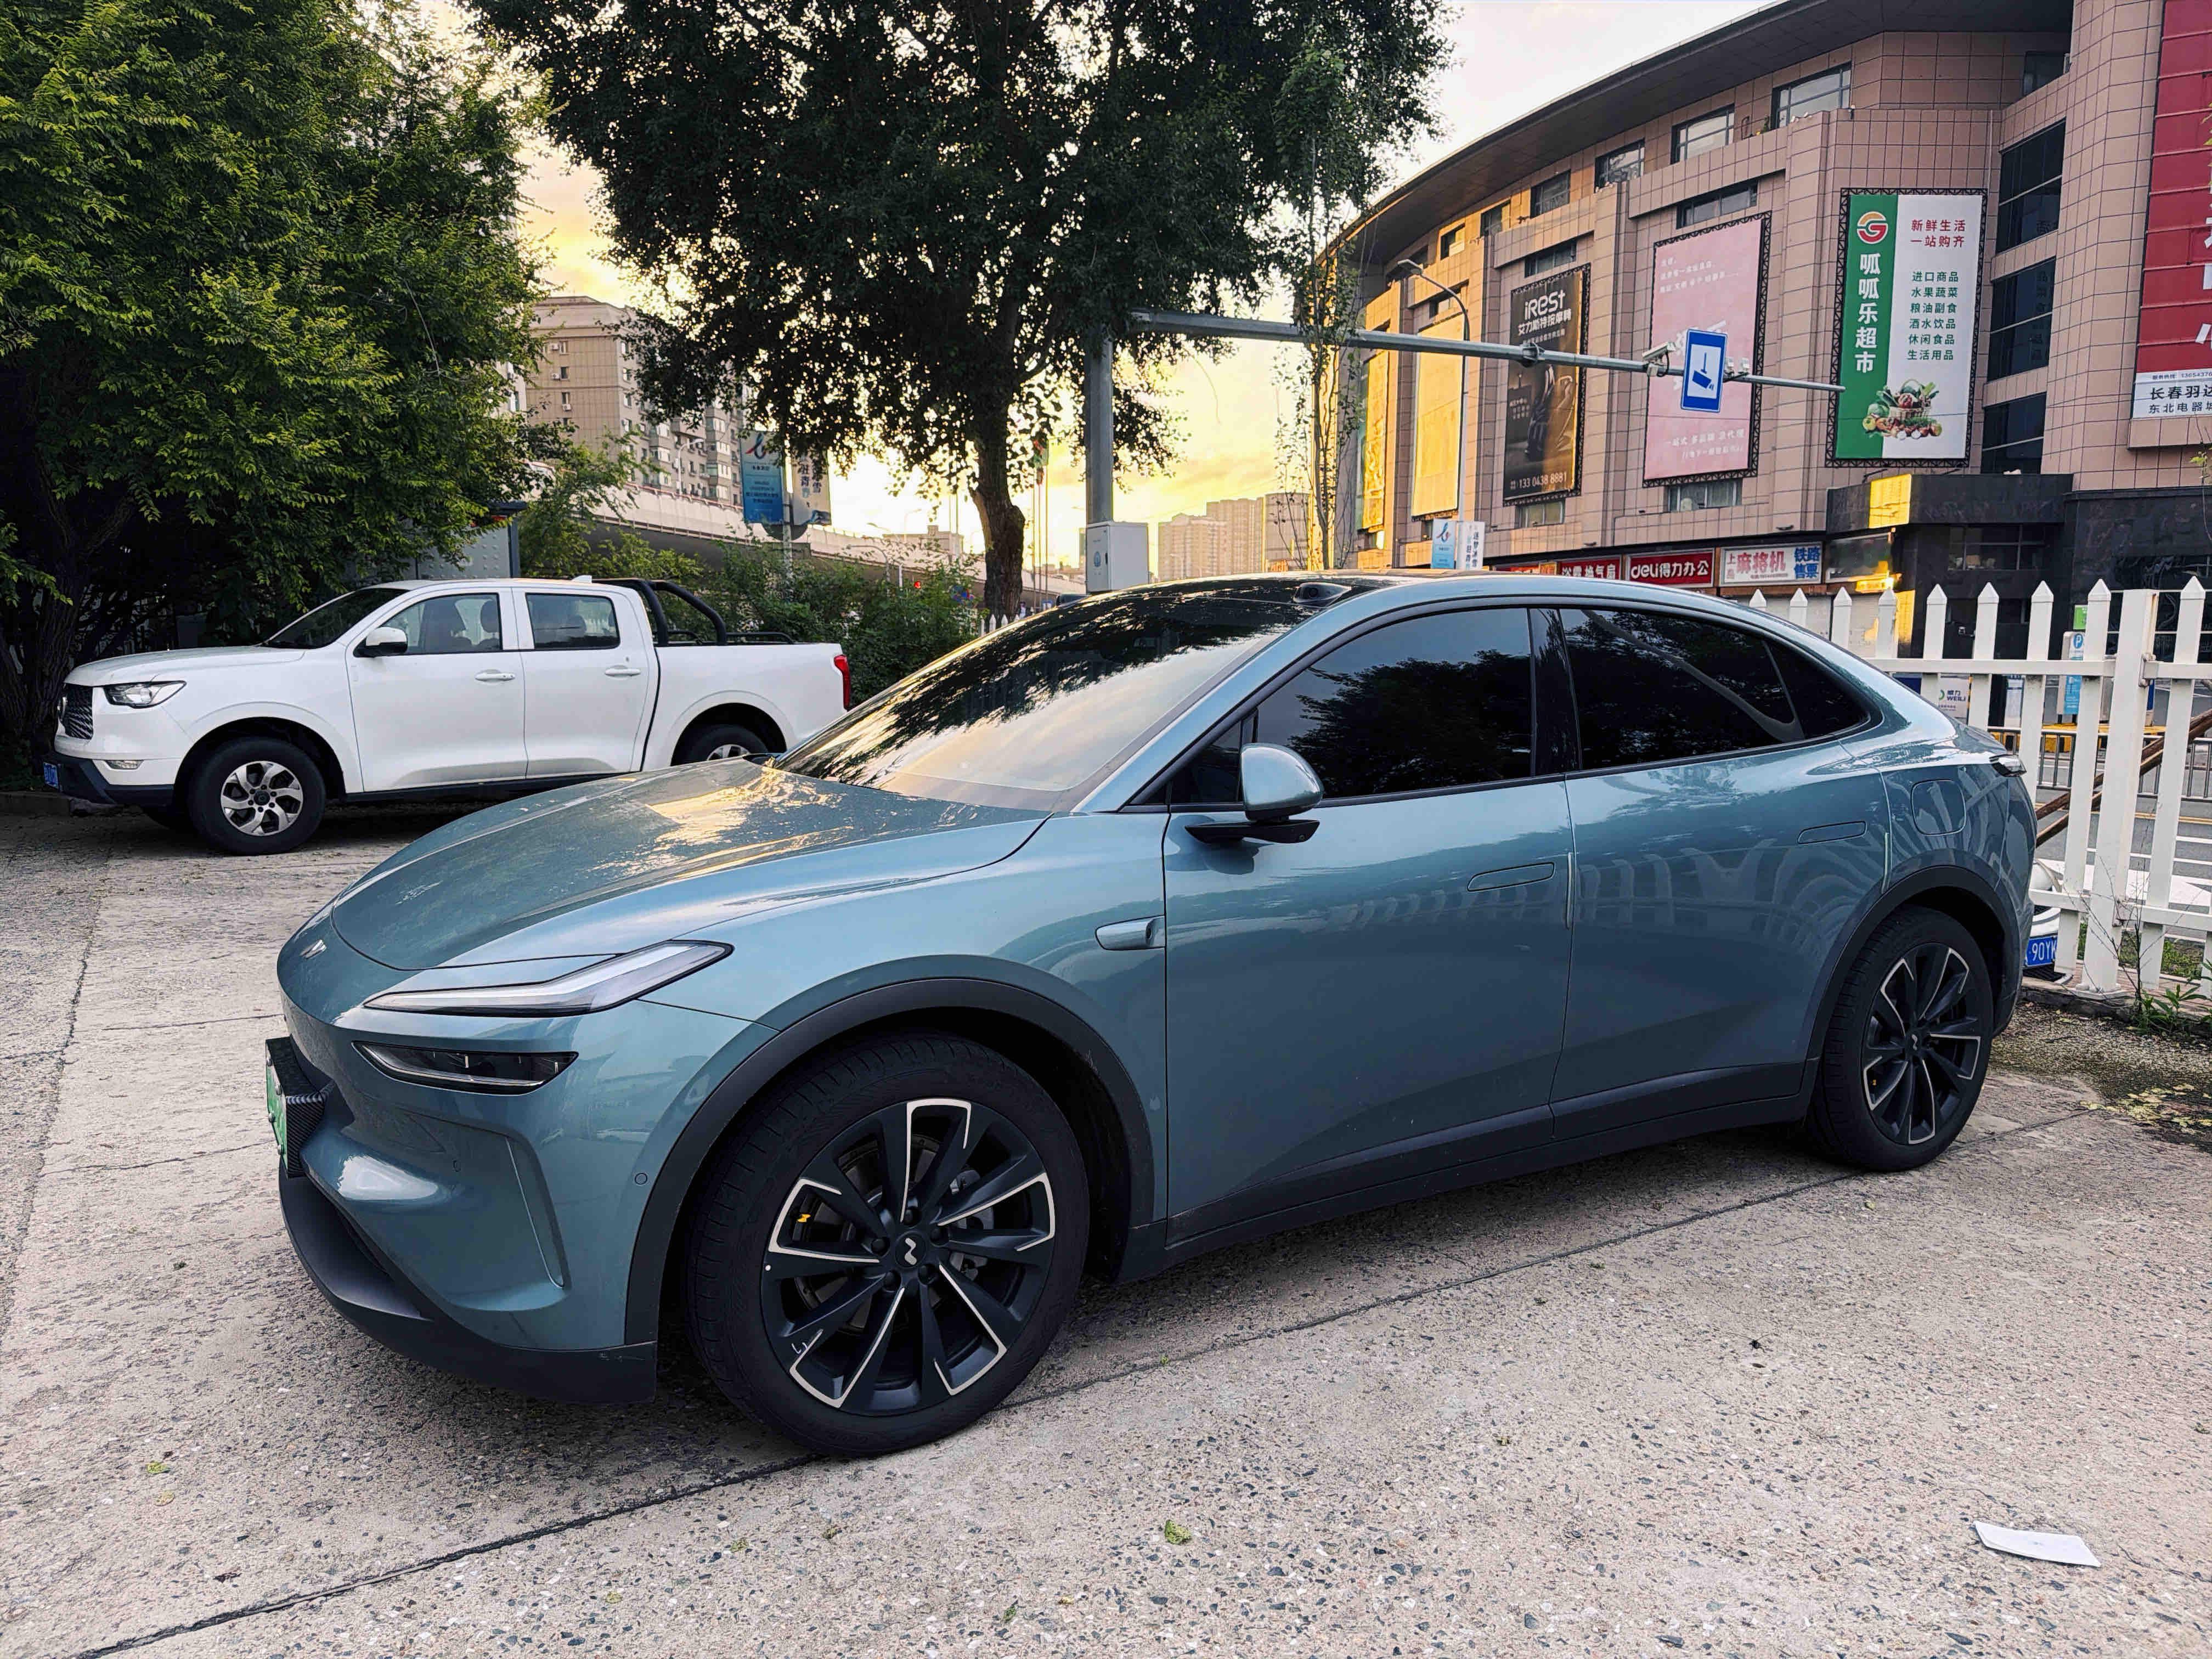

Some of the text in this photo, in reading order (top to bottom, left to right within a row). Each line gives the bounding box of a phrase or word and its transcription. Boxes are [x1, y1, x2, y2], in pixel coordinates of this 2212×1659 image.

[1911, 219, 1966, 232] 新鲜生活
[1910, 235, 1965, 247] 一站购齐
[1912, 271, 1959, 283] 进口商品
[1911, 287, 1959, 298] 水果蔬菜
[1854, 252, 1881, 374] 呱呱乐超市
[1910, 302, 1957, 314] 粮油副食
[1909, 318, 1956, 329] 酒水饮品
[1908, 334, 1955, 345] 休闲食品
[1906, 349, 1954, 360] 生活用品
[1737, 551, 1786, 574] 麻将机
